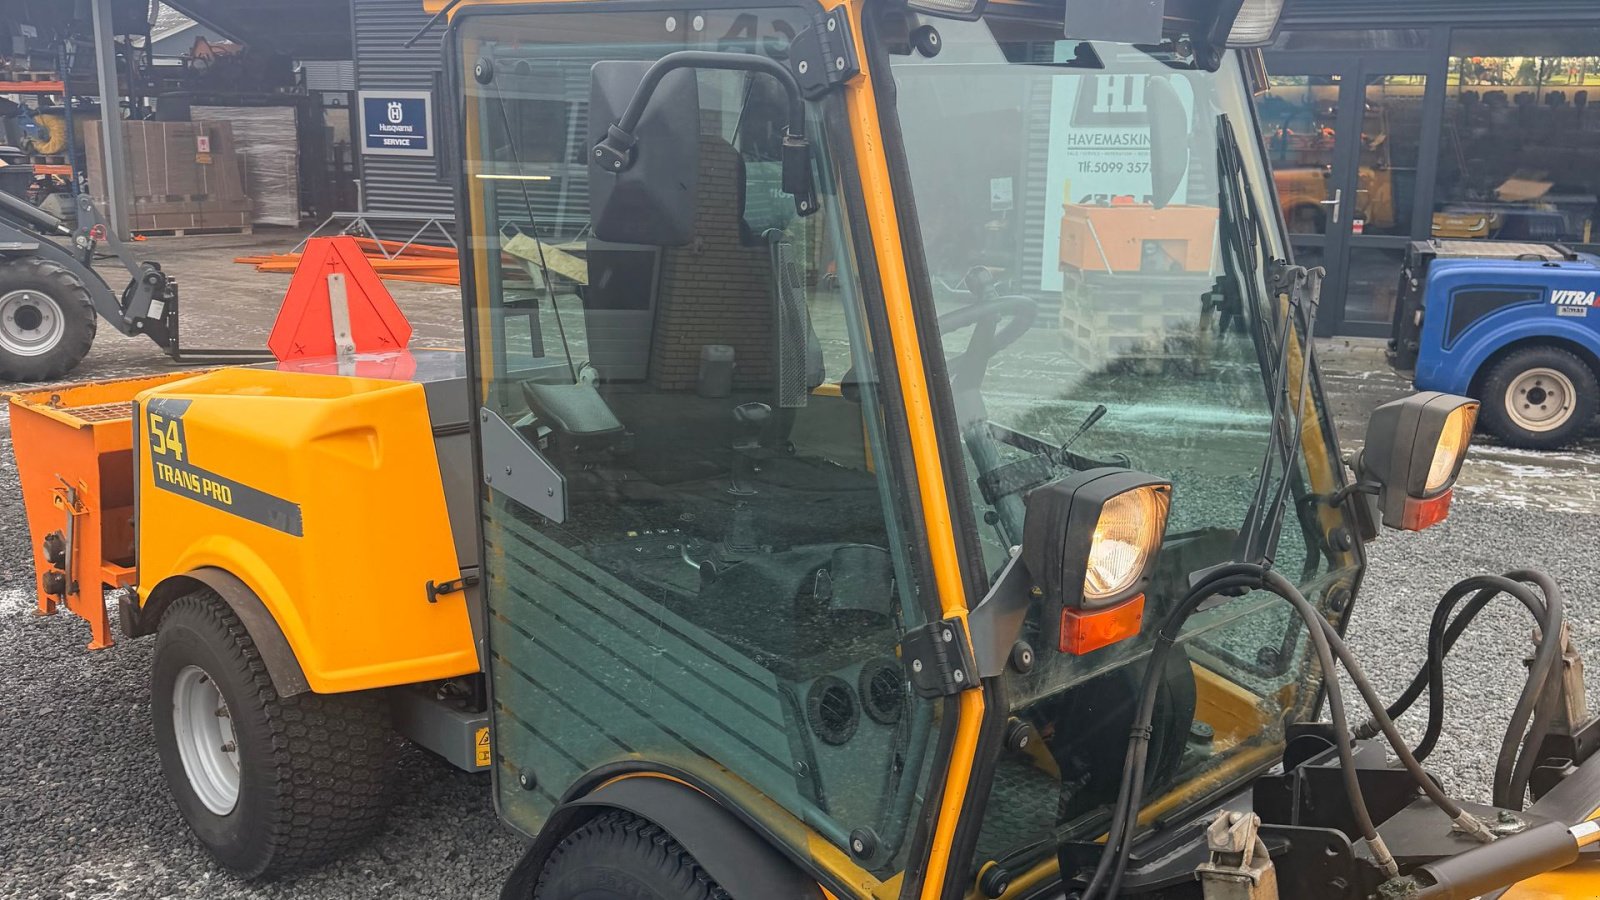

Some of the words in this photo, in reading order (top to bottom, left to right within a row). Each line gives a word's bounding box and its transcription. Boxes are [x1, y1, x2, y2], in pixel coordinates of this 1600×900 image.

[379, 123, 413, 132] Husqvarna
[383, 138, 410, 146] SERVICE
[1078, 161, 1123, 173] Tlf.5099
[1126, 162, 1151, 173] 357
[1550, 290, 1596, 306] VITRA
[150, 413, 183, 461] 54
[156, 461, 201, 493] TRANS
[202, 477, 232, 505] PRO
